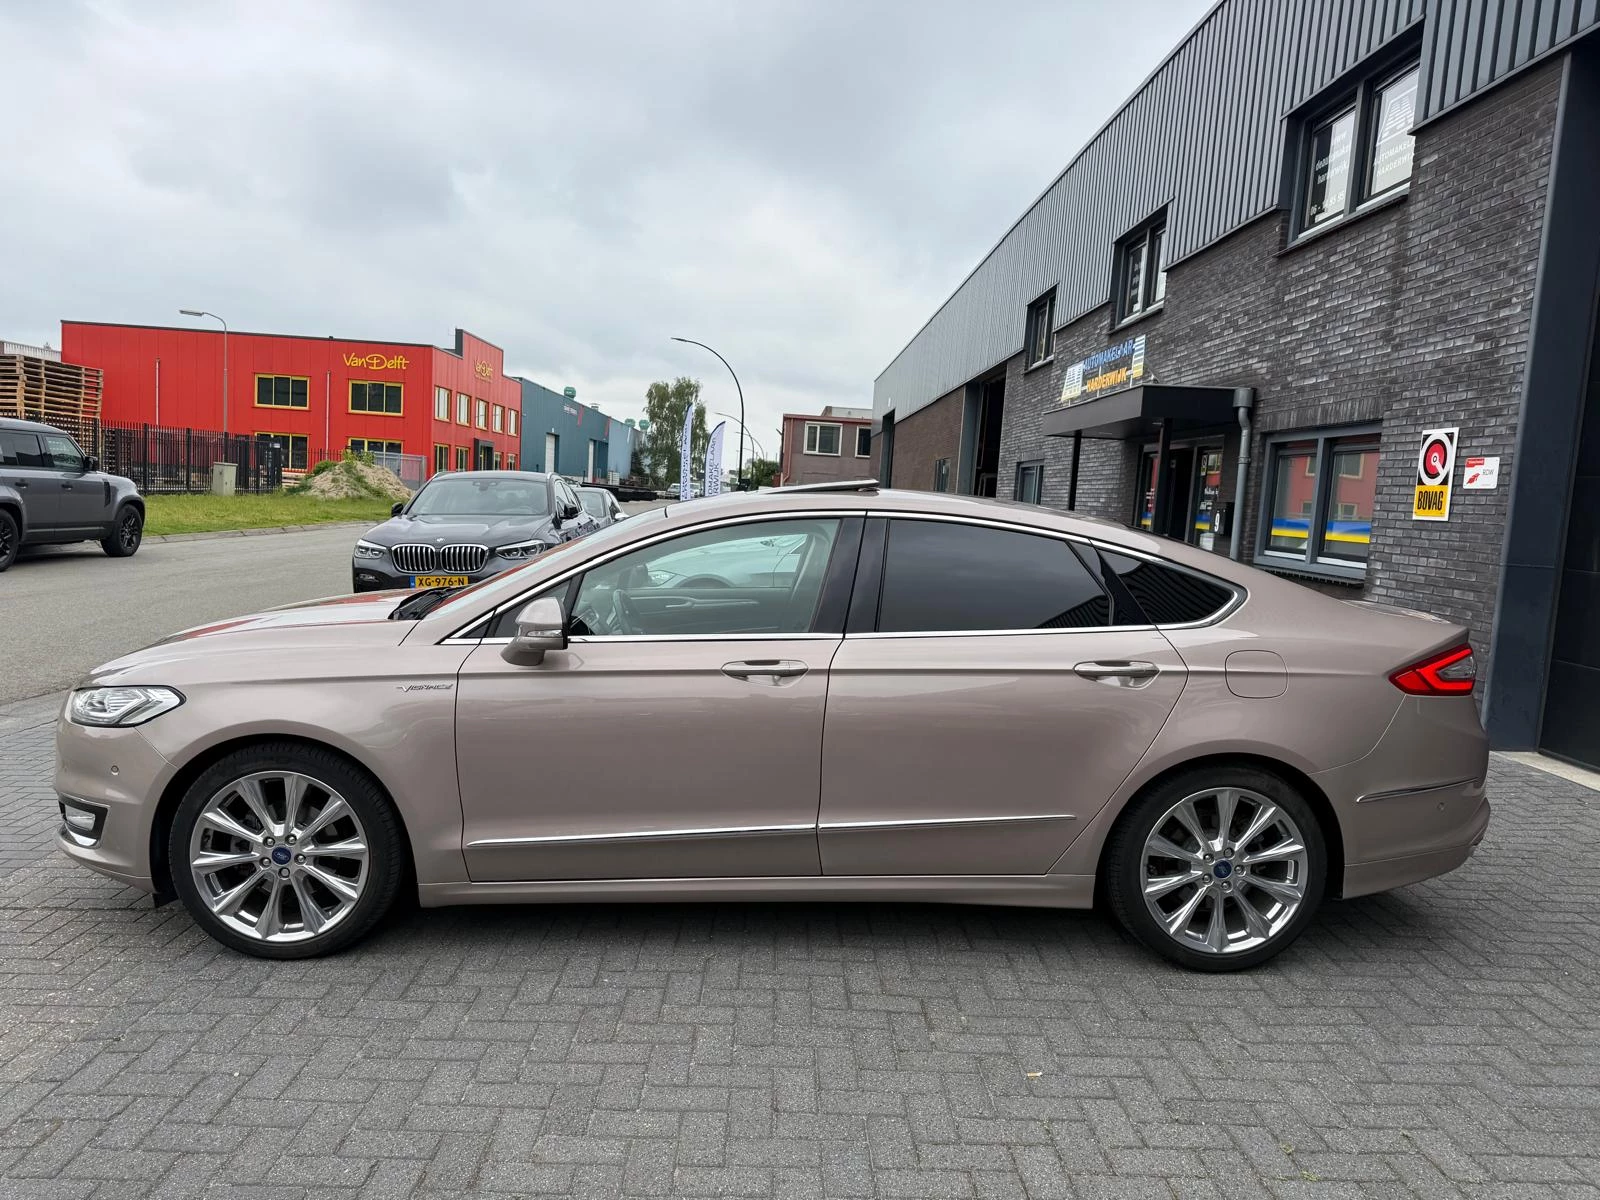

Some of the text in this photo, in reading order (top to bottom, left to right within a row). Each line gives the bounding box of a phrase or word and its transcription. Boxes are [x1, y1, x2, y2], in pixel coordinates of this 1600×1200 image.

[1083, 339, 1134, 371] AUTOMAKELAAR
[1086, 367, 1127, 393] HARDERWIJK
[1417, 490, 1444, 511] BOVAG
[1214, 512, 1220, 532] 9
[418, 578, 465, 587] XG-976-N
